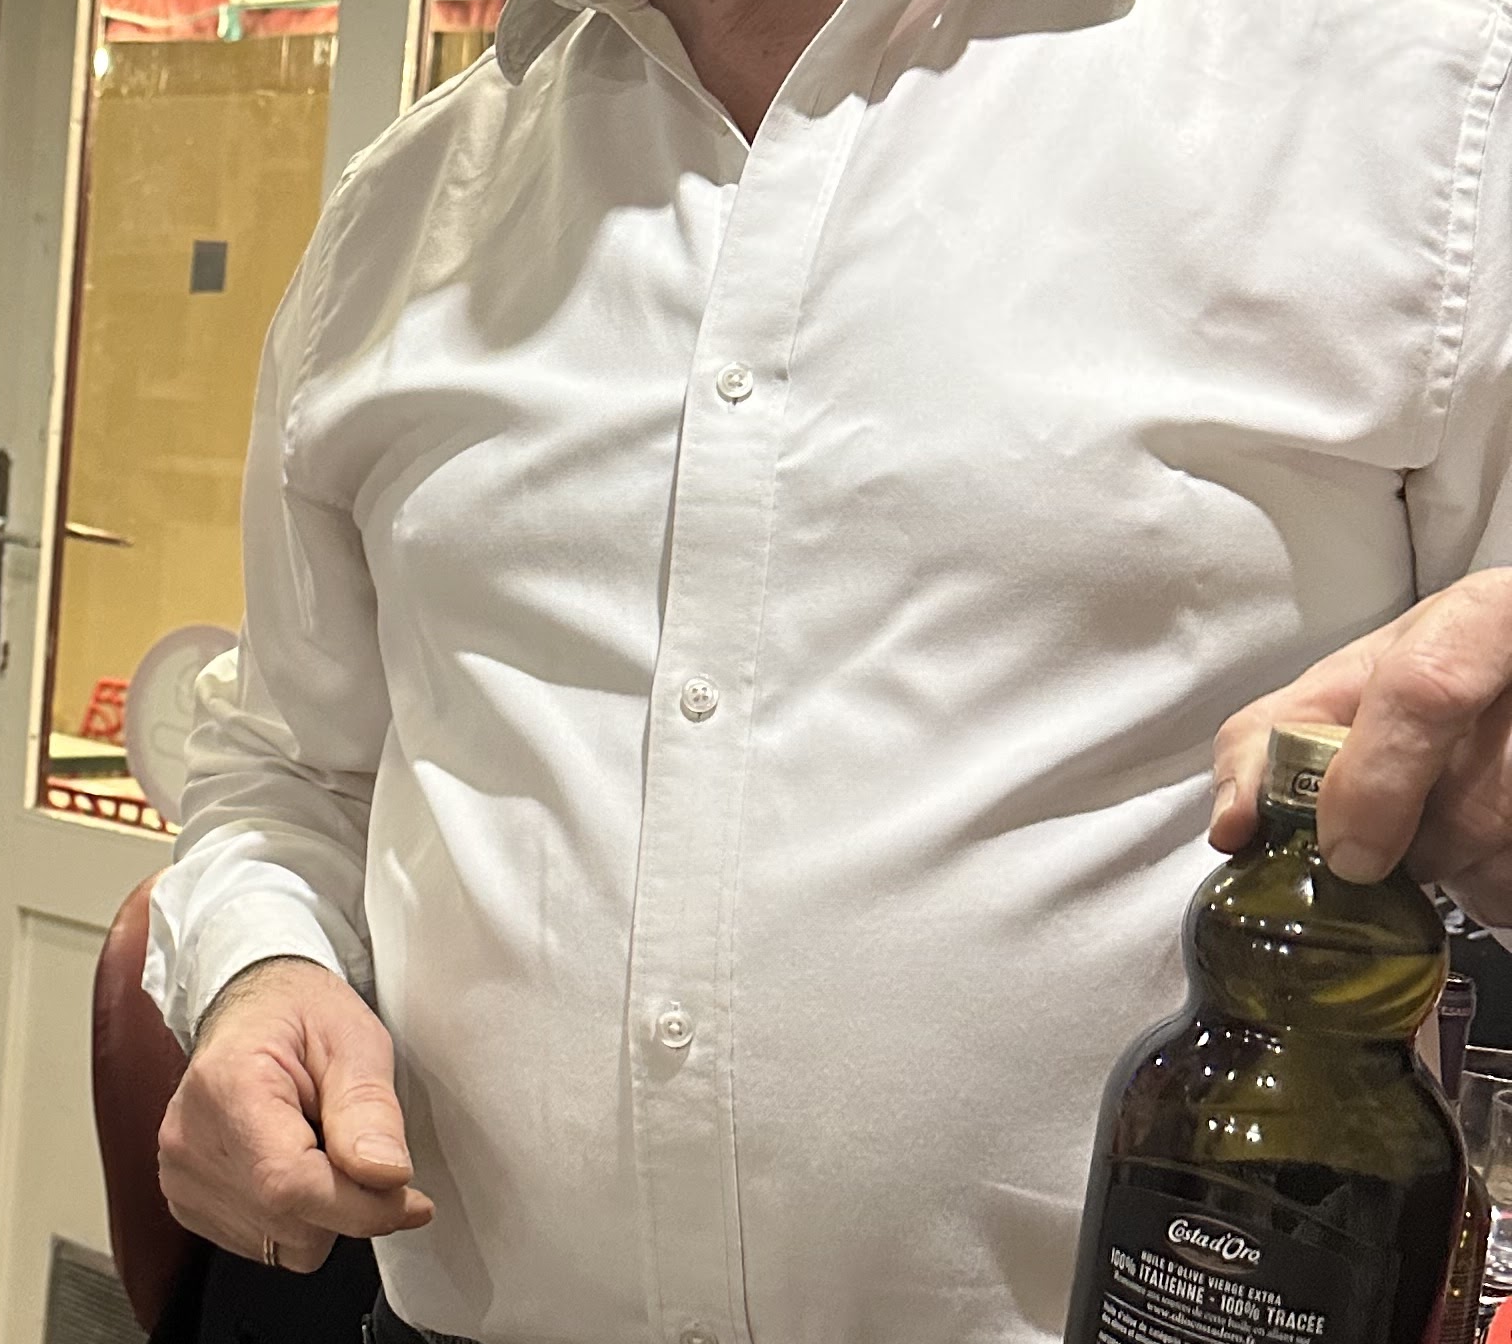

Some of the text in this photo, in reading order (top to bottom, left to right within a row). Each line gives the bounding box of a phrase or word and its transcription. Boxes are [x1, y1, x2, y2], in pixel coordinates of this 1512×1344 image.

[1168, 1218, 1261, 1262] Costa d'Oro
[1110, 1247, 1137, 1276] 100%
[1139, 1264, 1205, 1304] ITALIENNE
[1220, 1294, 1261, 1321] 100%
[1266, 1306, 1326, 1336] TRACÉE
[1141, 1250, 1165, 1270] HUILE
[1208, 1276, 1245, 1296] VIERGE
[1248, 1288, 1282, 1306] EXTRA
